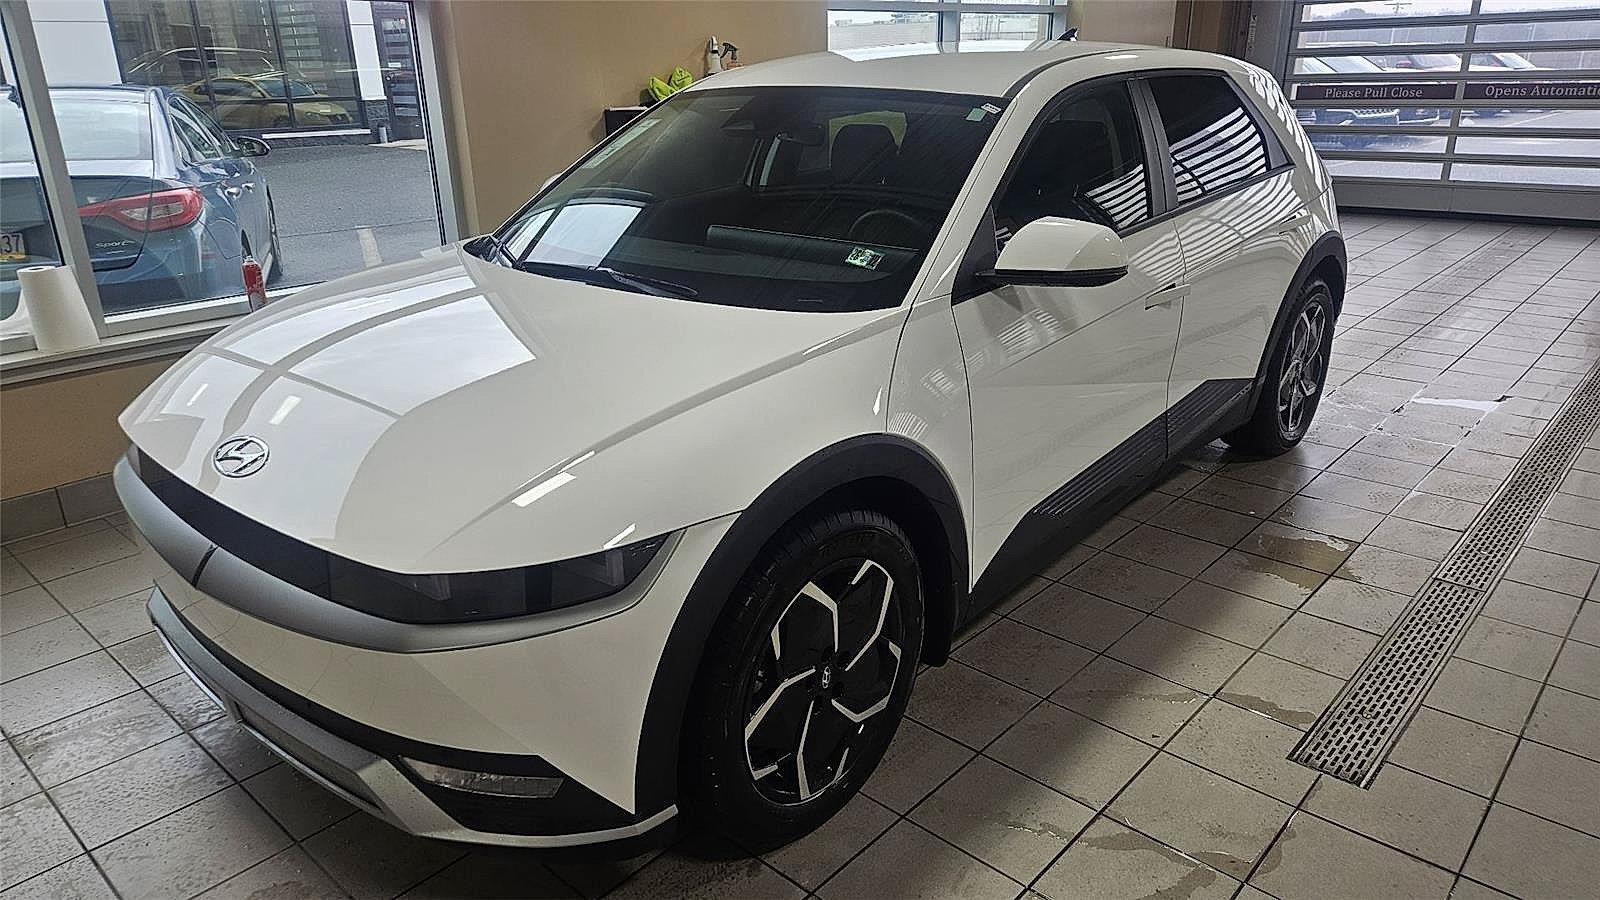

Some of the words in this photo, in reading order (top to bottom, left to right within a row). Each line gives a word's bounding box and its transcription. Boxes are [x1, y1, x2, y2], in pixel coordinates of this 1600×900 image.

[1325, 87, 1361, 98] Please
[1364, 87, 1387, 98] Pull
[1391, 87, 1423, 98] Close
[1485, 85, 1527, 98] Opens
[0, 234, 20, 253] 37
